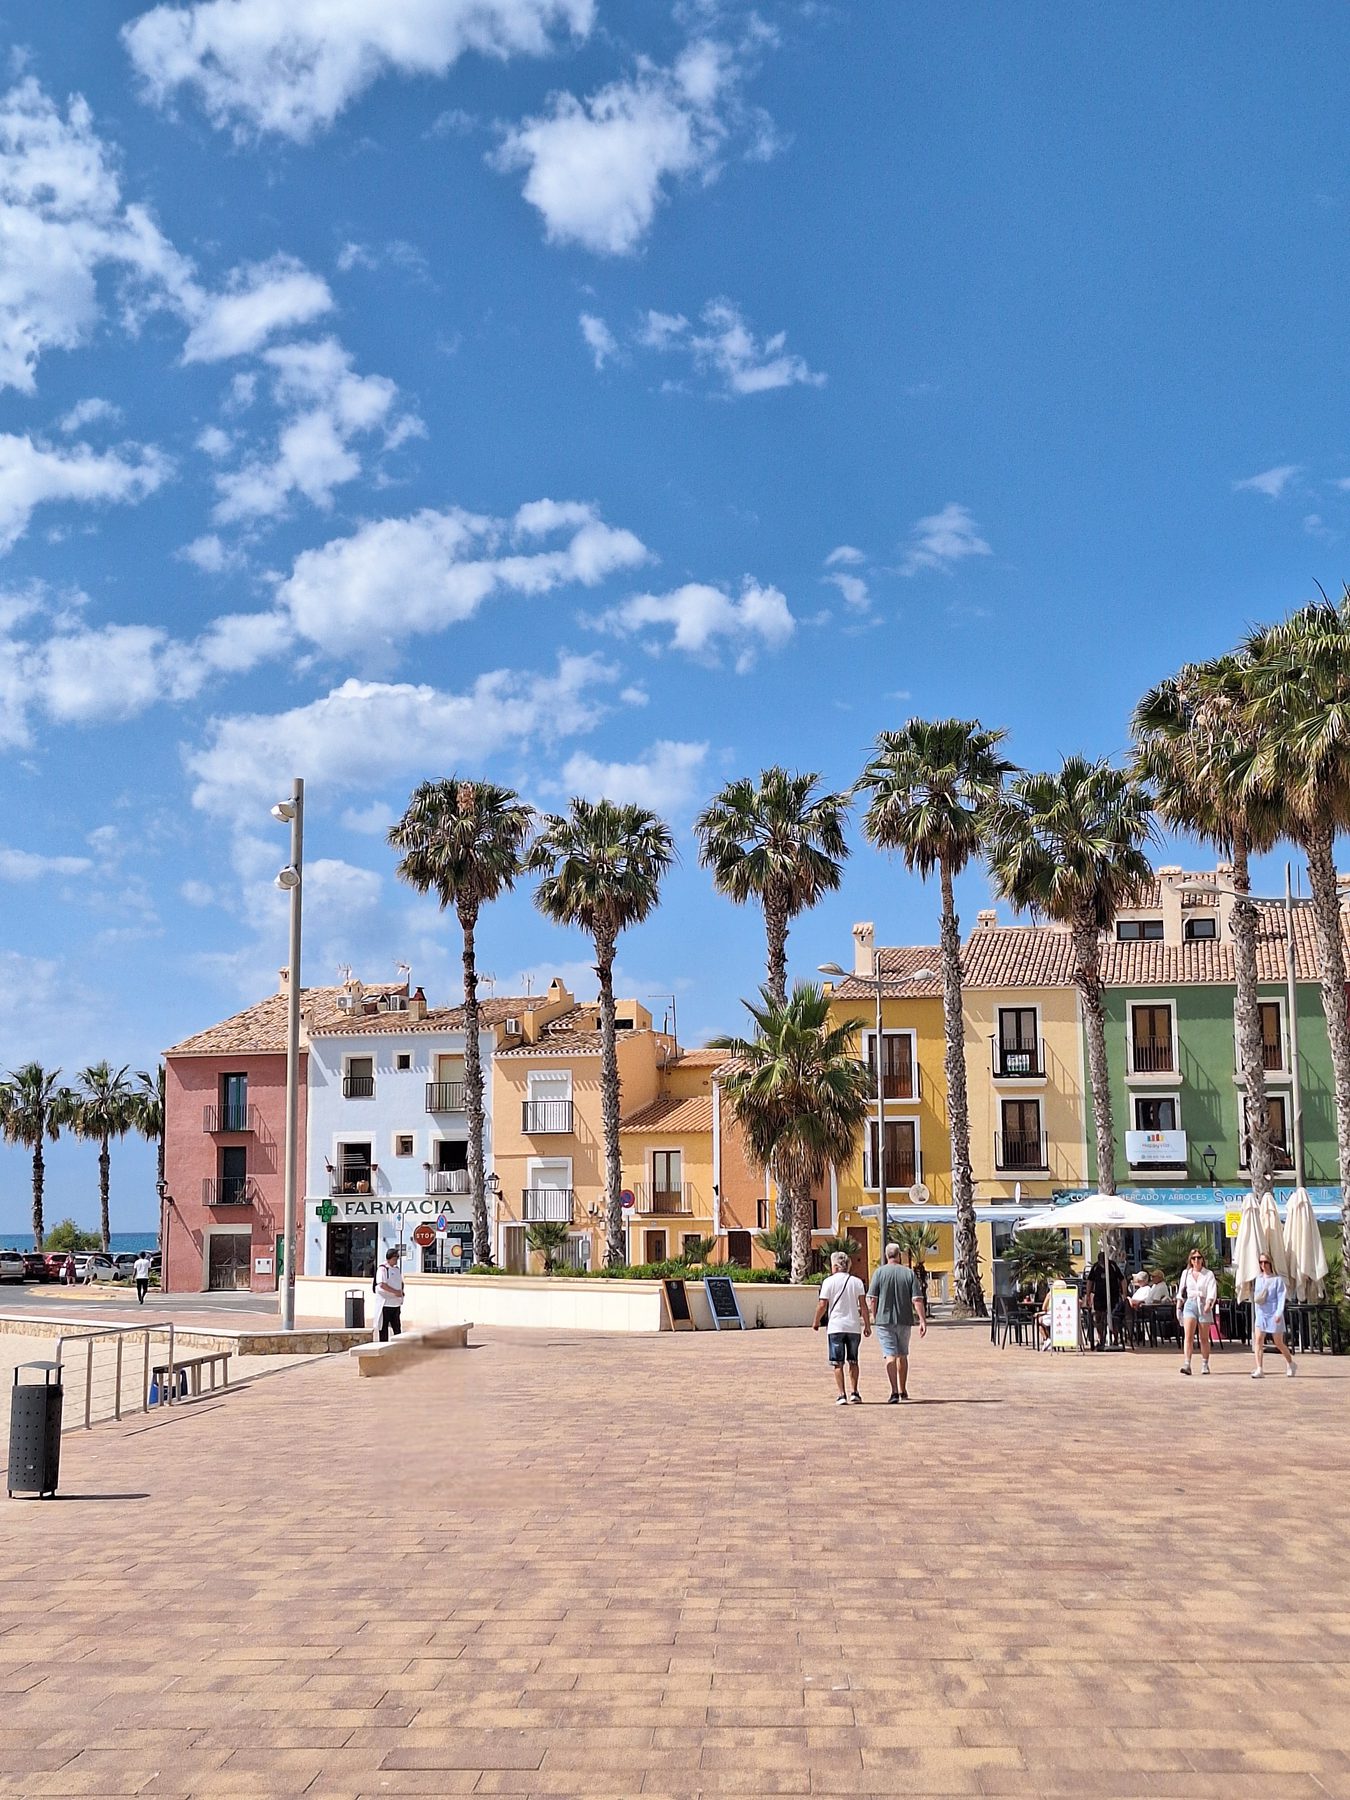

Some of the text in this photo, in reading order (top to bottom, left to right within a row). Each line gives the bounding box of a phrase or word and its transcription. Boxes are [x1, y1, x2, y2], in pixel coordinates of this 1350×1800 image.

[1161, 1193, 1167, 1201] Y
[1168, 1193, 1207, 1201] ARROCES
[345, 1200, 455, 1215] FARMACIA
